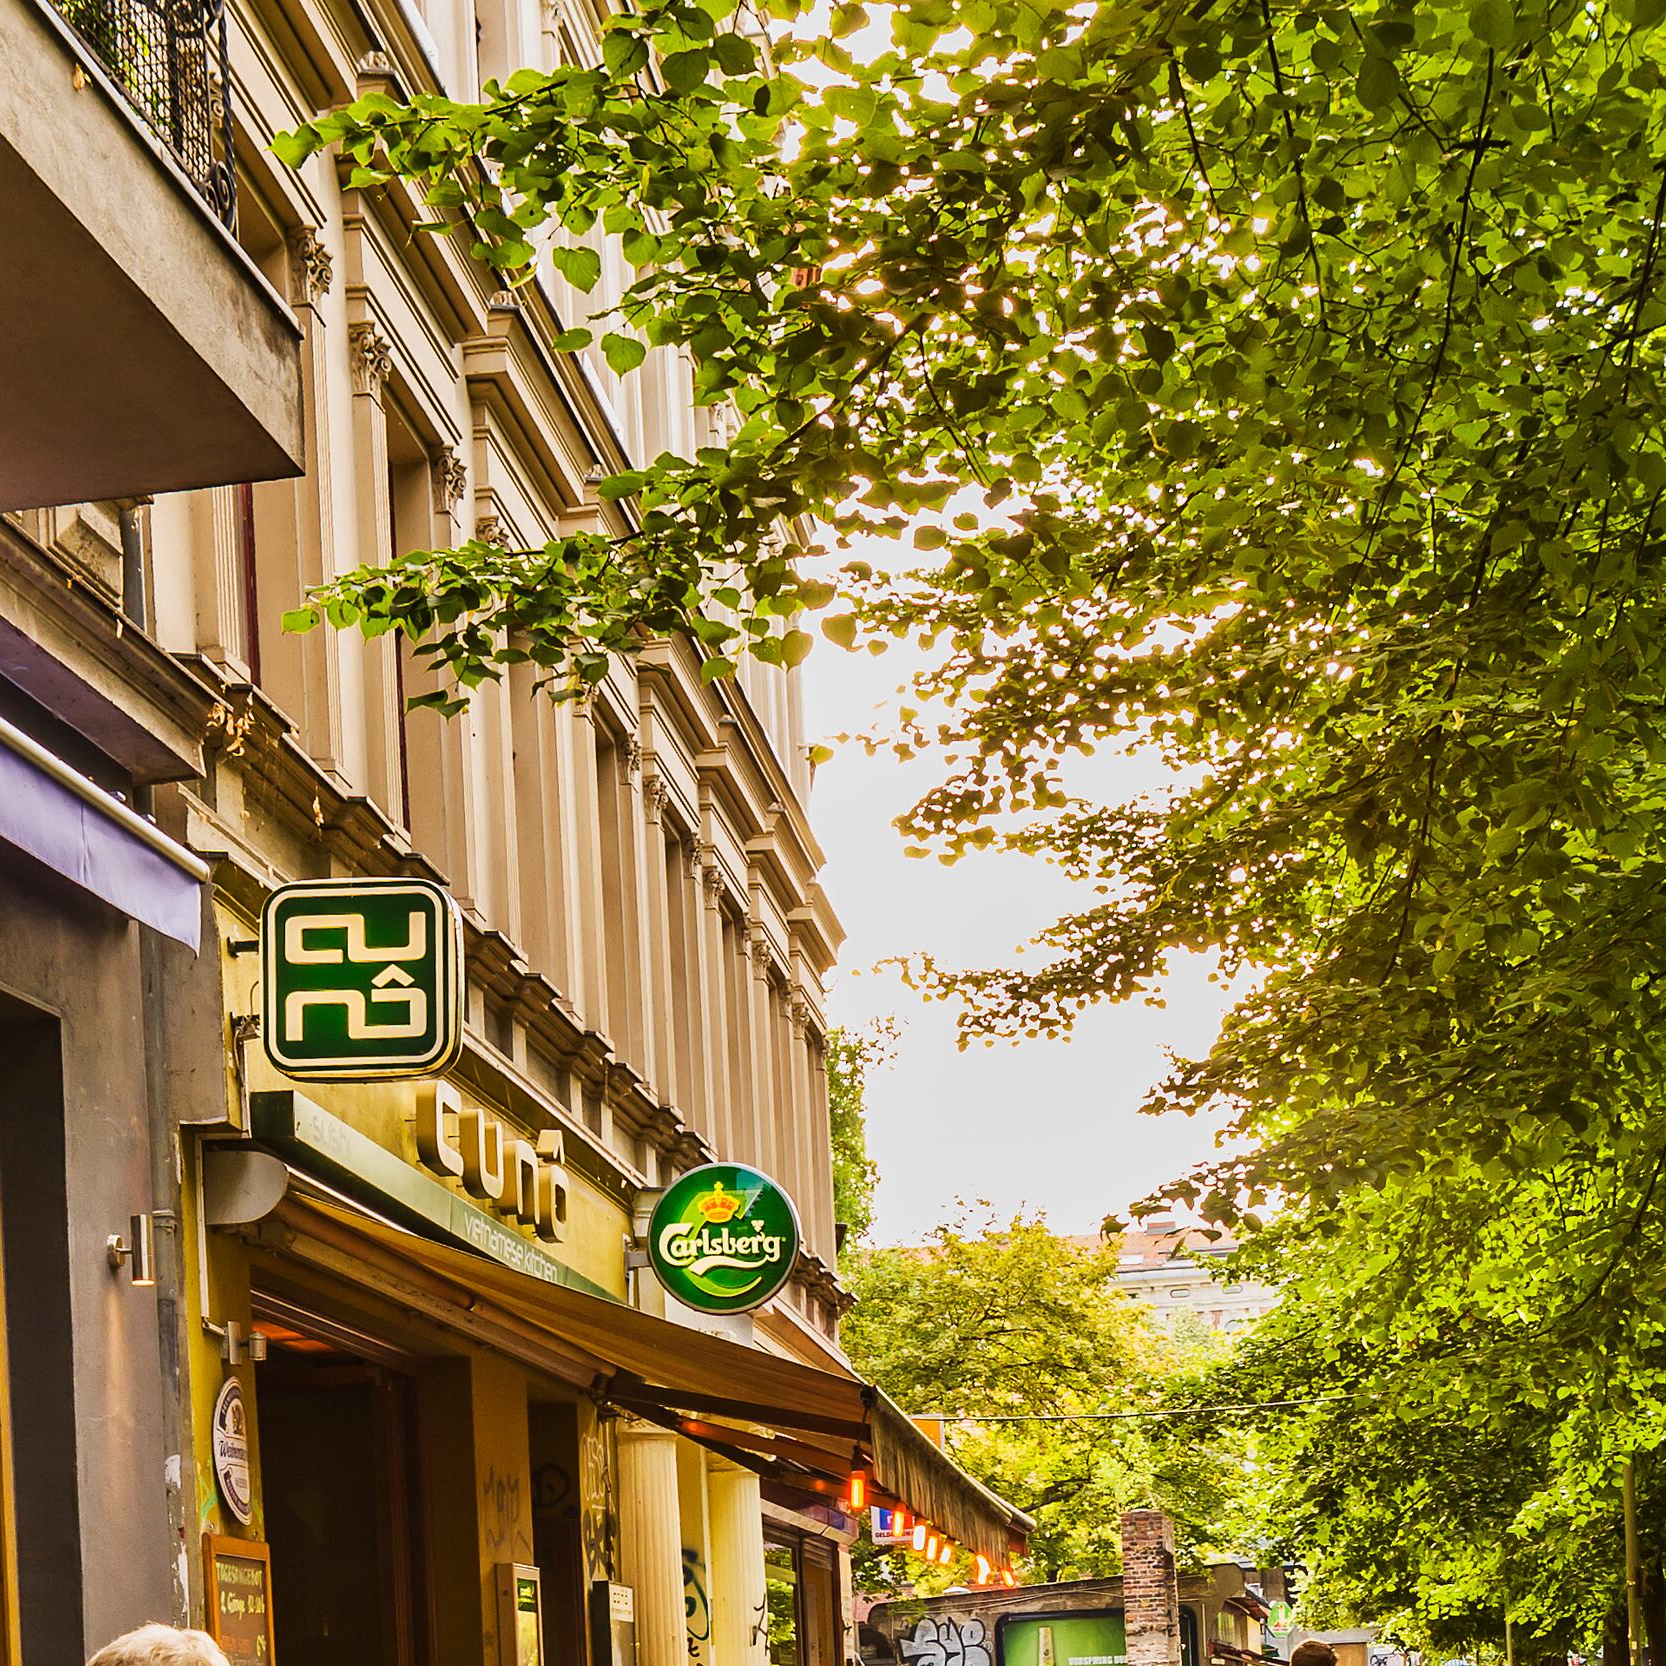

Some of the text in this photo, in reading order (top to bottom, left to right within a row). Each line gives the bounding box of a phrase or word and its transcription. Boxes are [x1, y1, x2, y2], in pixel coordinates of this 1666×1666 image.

[464, 1211, 558, 1284] vietnamese kitchen
[659, 1221, 781, 1268] Carlsberg
